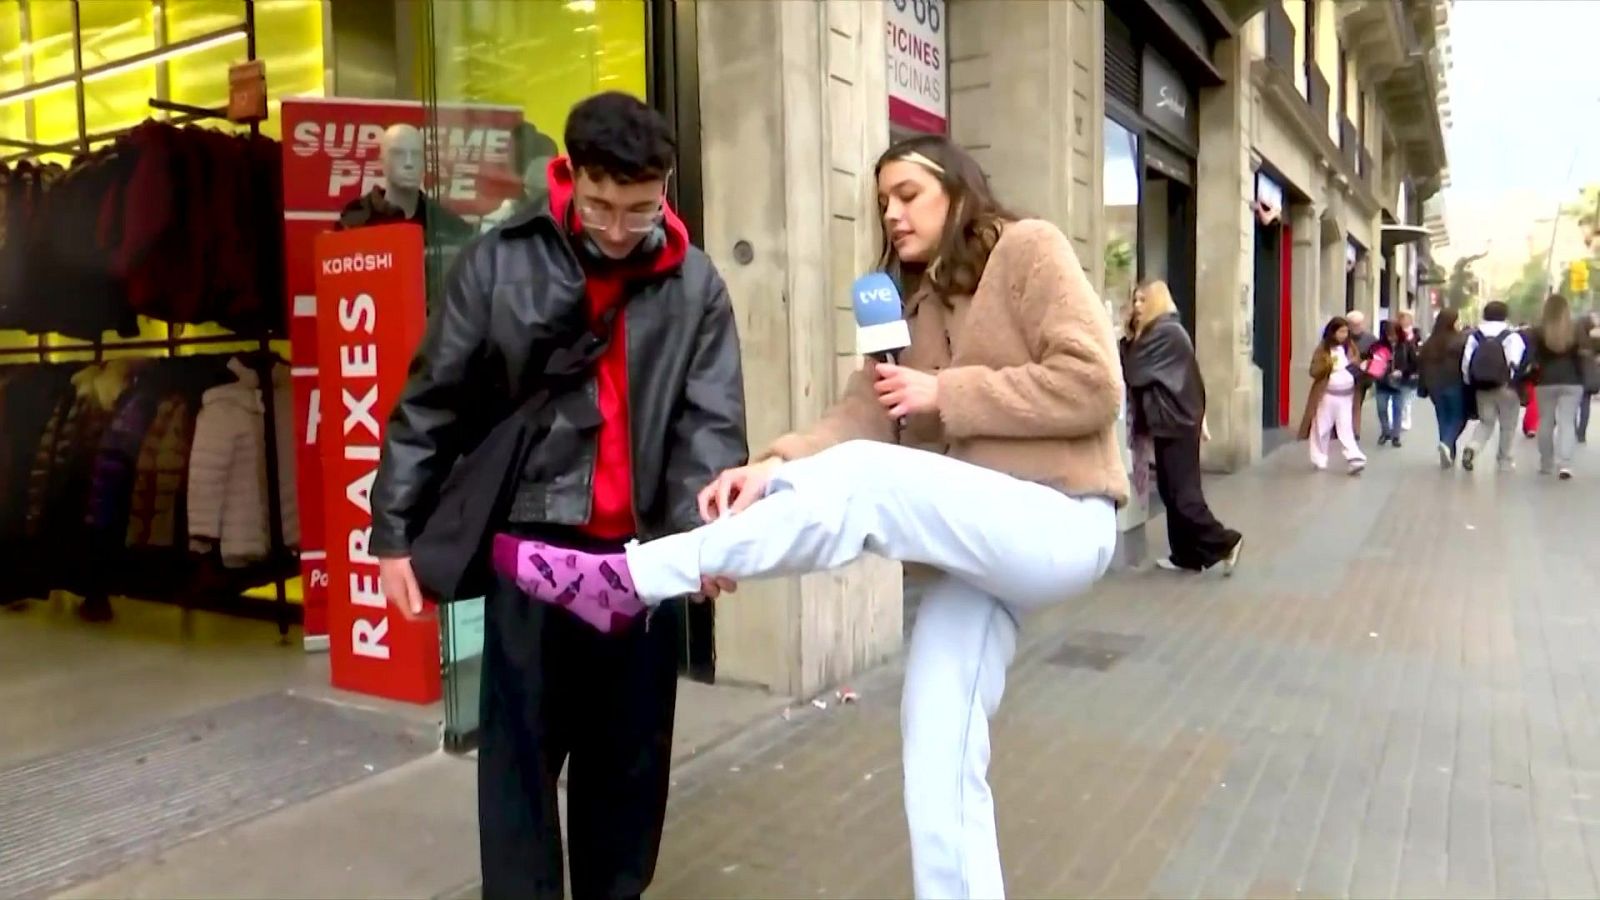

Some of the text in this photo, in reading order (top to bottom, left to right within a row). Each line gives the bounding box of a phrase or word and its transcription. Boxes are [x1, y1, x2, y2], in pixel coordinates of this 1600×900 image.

[292, 121, 512, 161] SUPEME
[328, 159, 480, 199] PRCE
[860, 287, 893, 304] tve
